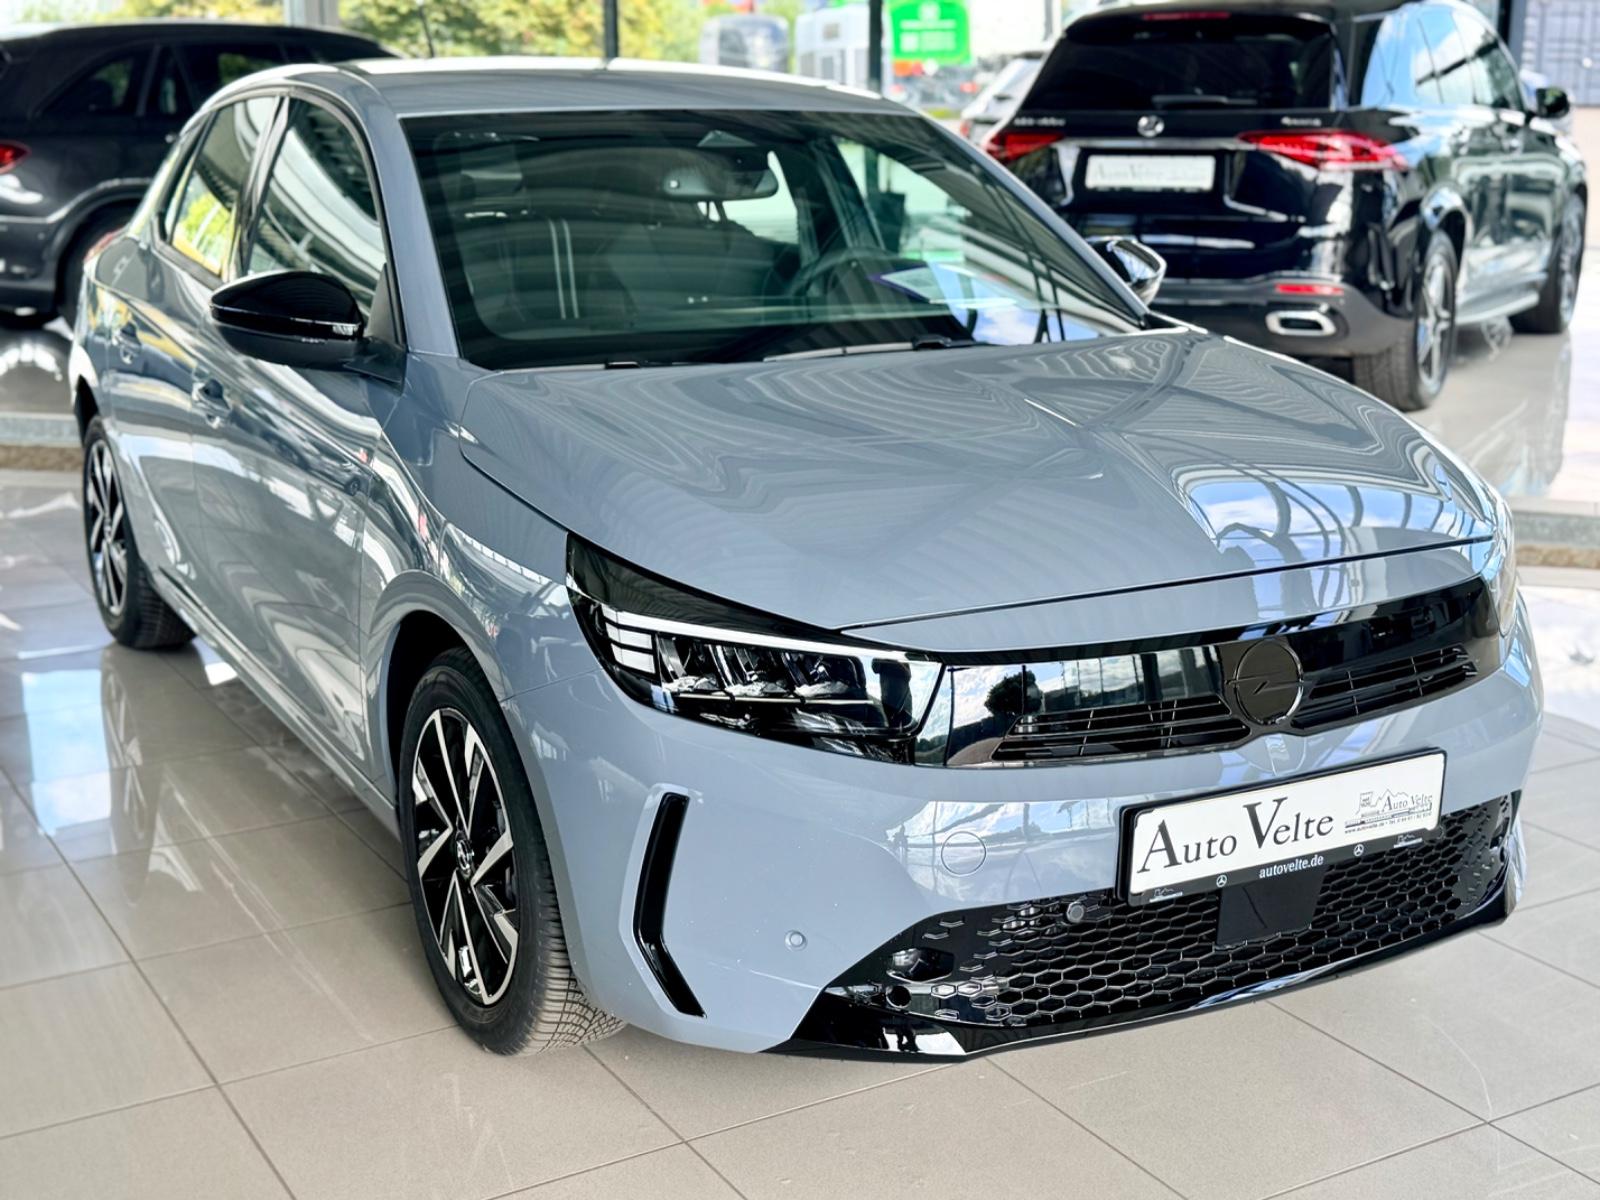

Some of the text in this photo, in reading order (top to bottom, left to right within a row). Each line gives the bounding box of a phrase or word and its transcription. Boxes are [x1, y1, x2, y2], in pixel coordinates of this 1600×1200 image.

[1136, 796, 1334, 874] Auto Velte
[1258, 854, 1324, 879] autovelte.de
